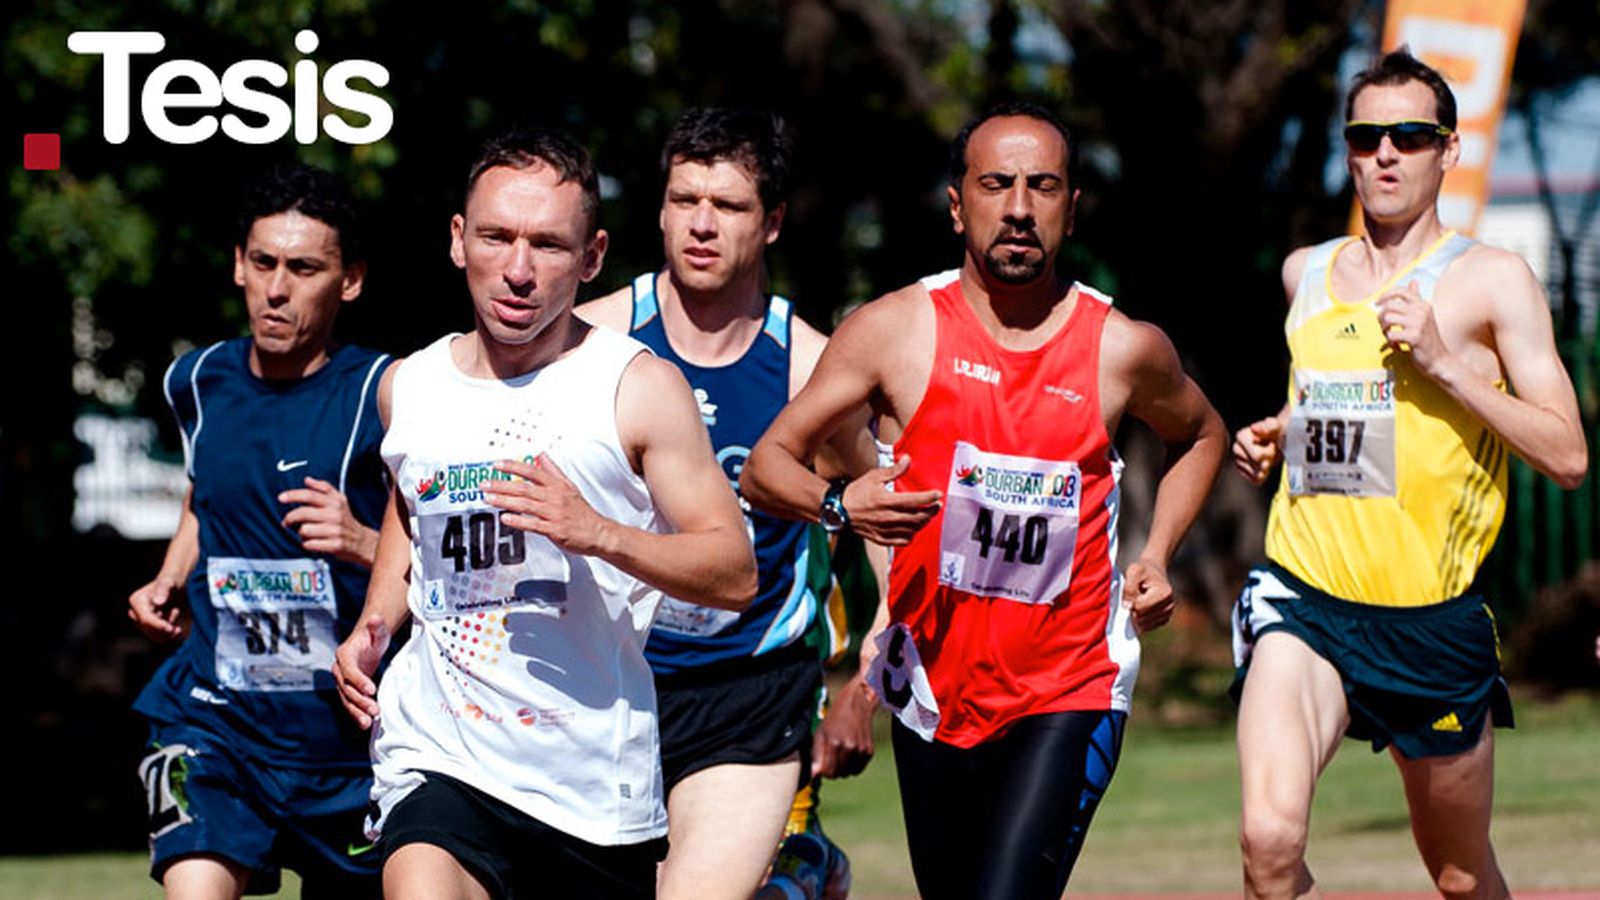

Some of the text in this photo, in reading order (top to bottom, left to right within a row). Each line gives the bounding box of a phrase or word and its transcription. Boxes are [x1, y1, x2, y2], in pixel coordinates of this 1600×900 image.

[1306, 419, 1365, 464] 397
[449, 490, 484, 503] SOUT
[985, 489, 1075, 509] SOUTH AFRICA
[986, 471, 1044, 495] DURBAN
[441, 511, 526, 573] 405
[971, 506, 1049, 566] 440
